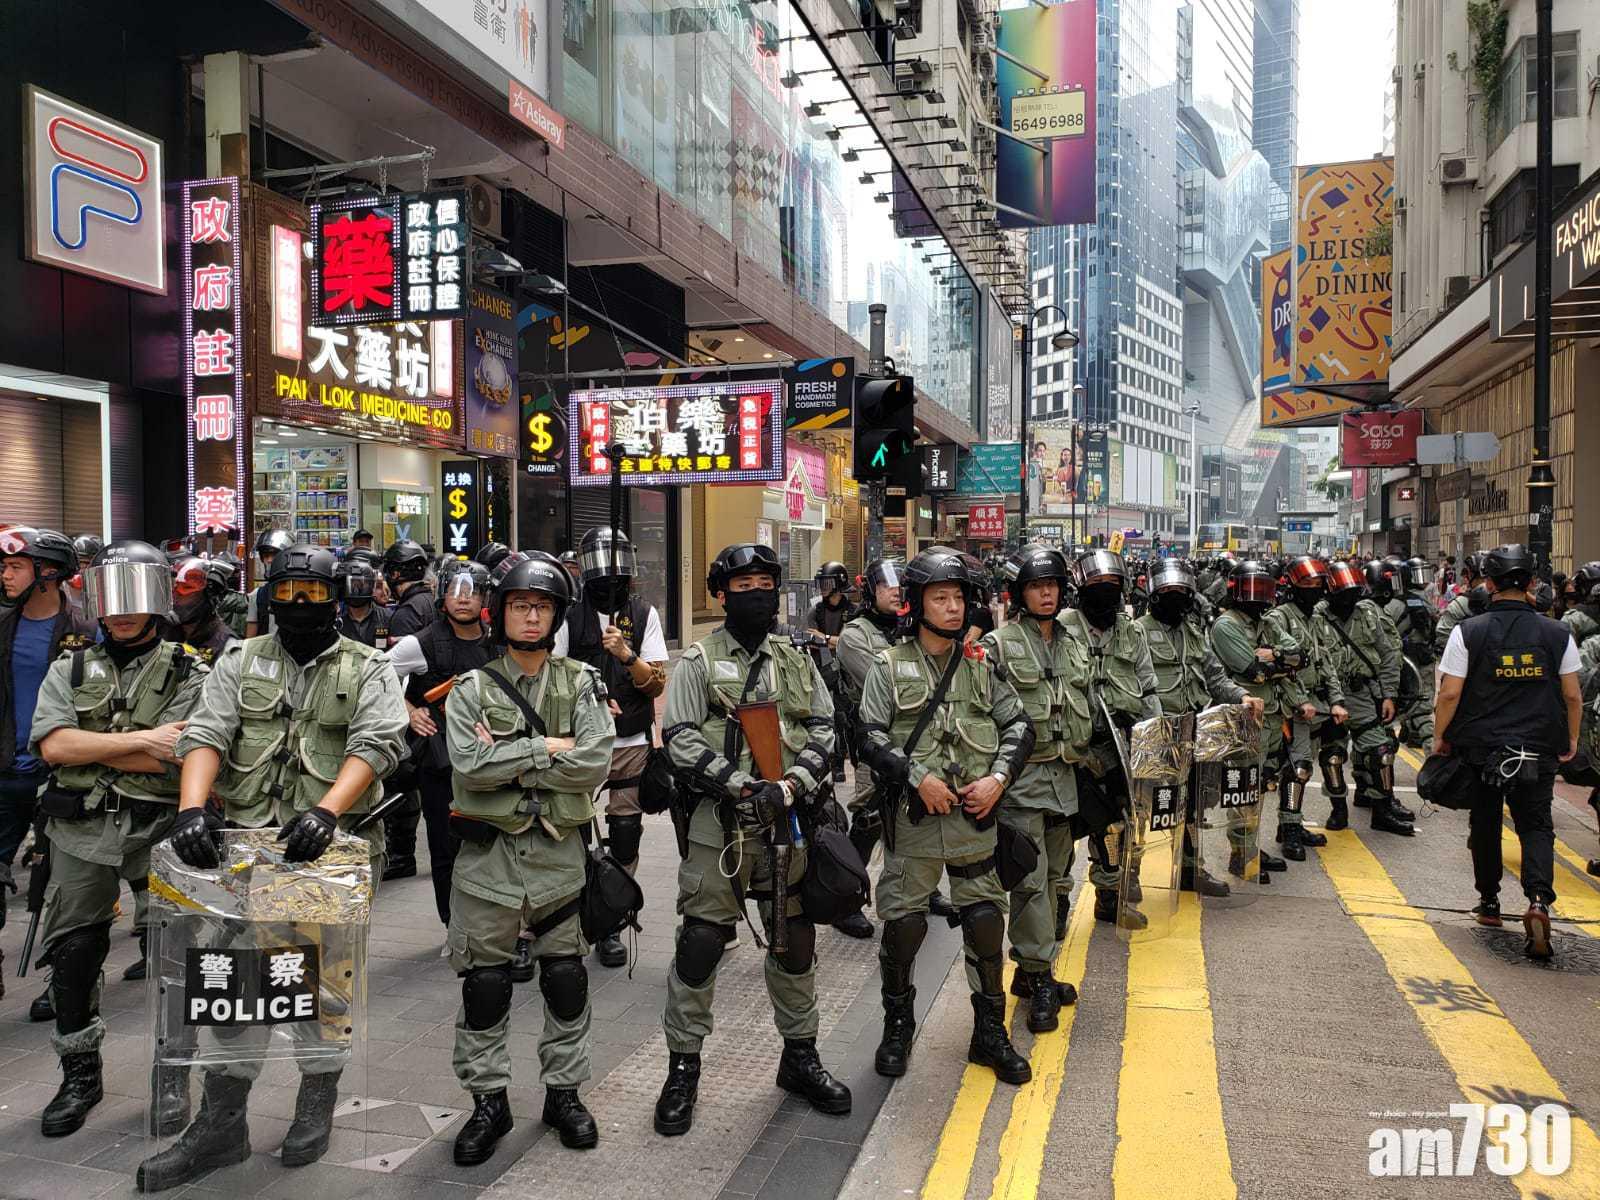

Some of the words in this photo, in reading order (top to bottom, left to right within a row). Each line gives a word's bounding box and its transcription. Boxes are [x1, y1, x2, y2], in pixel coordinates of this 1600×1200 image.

[526, 103, 562, 144] Asiaray
[1013, 116, 1046, 132] 5649
[1049, 113, 1083, 128] 6988
[323, 213, 394, 312] 藥
[407, 201, 432, 312] 政府註冊
[435, 198, 461, 310] 信心保證
[475, 336, 513, 360] EXCHANGE
[307, 325, 430, 397] 大藥坊
[191, 197, 236, 560] 政府註冊藥
[795, 381, 837, 393] FRESH
[320, 384, 356, 411] LOK
[360, 393, 428, 426] MEDICINE
[795, 393, 837, 401] HANDMADE
[795, 401, 837, 409] COSMETICS
[444, 472, 472, 486] 兌換
[528, 464, 556, 473] CHANGE
[528, 567, 554, 579] Police
[1495, 667, 1543, 678] POLICE
[1158, 788, 1172, 809] 警
[1223, 790, 1258, 805] POLICE
[200, 952, 304, 990] 警察
[190, 993, 313, 1021] POLICE
